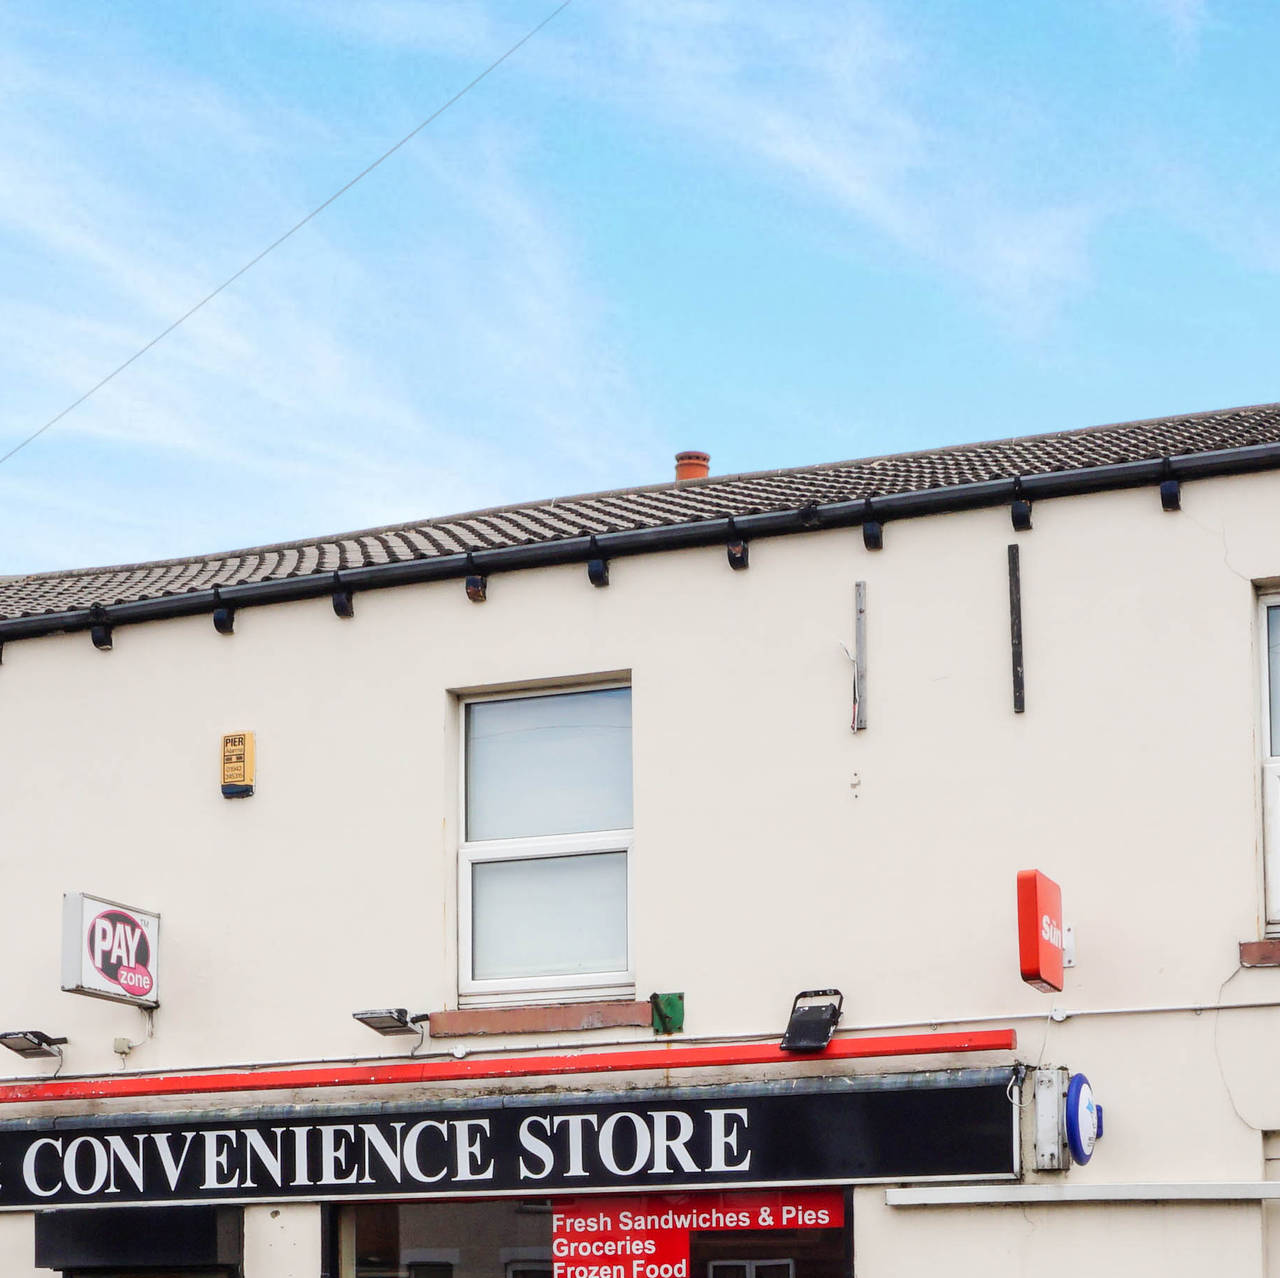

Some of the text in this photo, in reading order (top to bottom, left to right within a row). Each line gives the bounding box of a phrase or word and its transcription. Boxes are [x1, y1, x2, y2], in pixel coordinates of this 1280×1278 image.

[225, 736, 244, 748] PIER
[94, 918, 142, 969] PAY
[1041, 914, 1063, 950] Sun
[120, 970, 151, 990] zone
[22, 1118, 495, 1197] CONVENIENCE
[519, 1108, 752, 1180] STORE
[552, 1205, 830, 1233] Fresh Sandwiches & Pies
[552, 1237, 656, 1258] Groceries
[632, 1258, 687, 1278] Food
